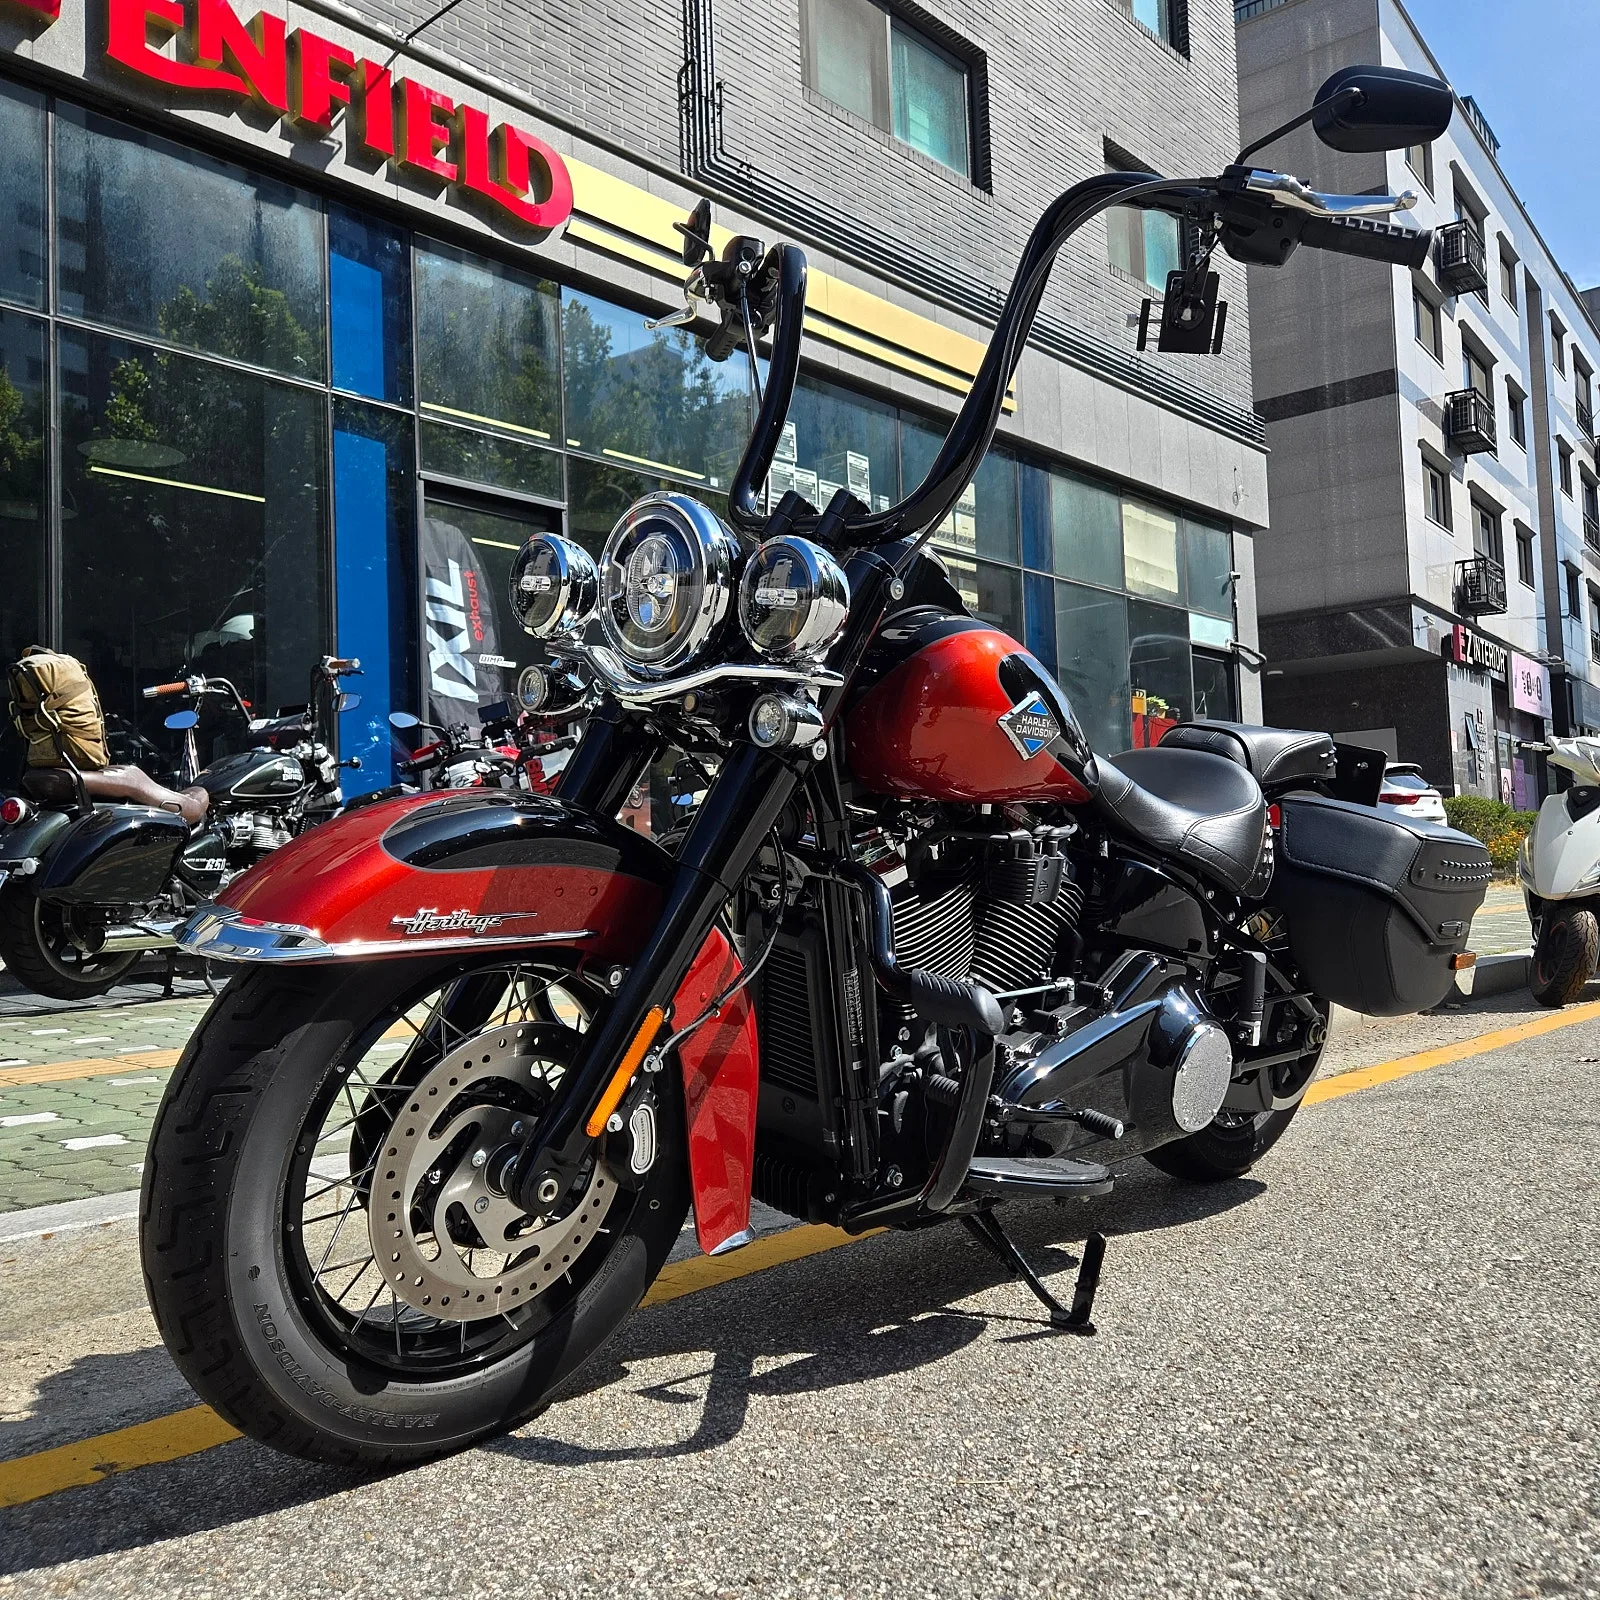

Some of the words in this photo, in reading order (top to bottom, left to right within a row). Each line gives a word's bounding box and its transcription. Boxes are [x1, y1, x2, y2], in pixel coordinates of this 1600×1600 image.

[105, 0, 574, 228] ENFIELD
[463, 570, 485, 642] exhaust
[1453, 624, 1474, 665] EZ
[1472, 634, 1507, 673] INTERIOR
[1015, 724, 1053, 738] DAVIDSON
[390, 908, 520, 934] Heritage
[253, 1303, 441, 1430] HARLEY-DAVIDSON
